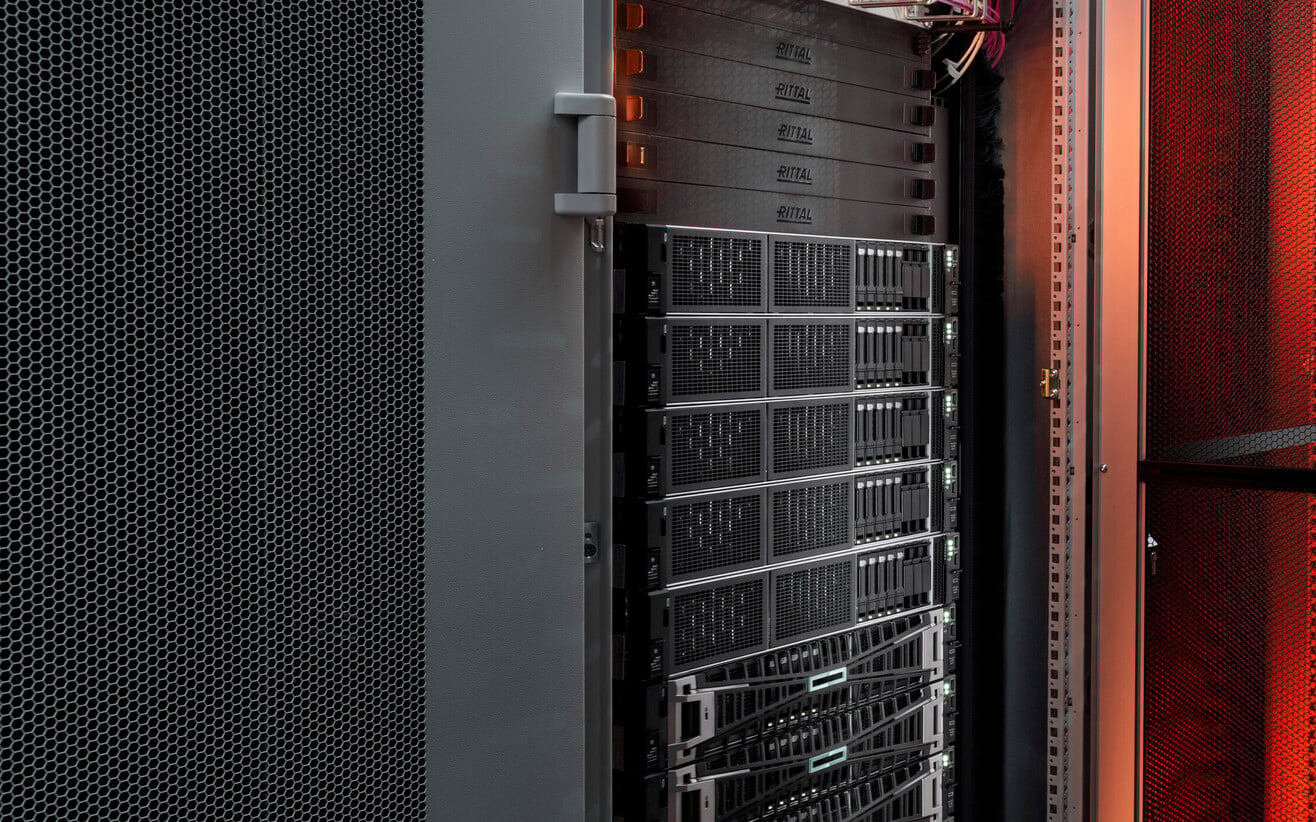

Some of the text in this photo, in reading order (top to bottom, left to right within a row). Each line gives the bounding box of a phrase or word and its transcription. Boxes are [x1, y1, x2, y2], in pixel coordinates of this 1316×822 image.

[776, 42, 811, 60] RITTAL
[775, 83, 810, 100] RITTAL
[778, 124, 812, 140] RITTAL
[777, 165, 812, 180] RITTAL
[777, 206, 812, 220] RITTAL
